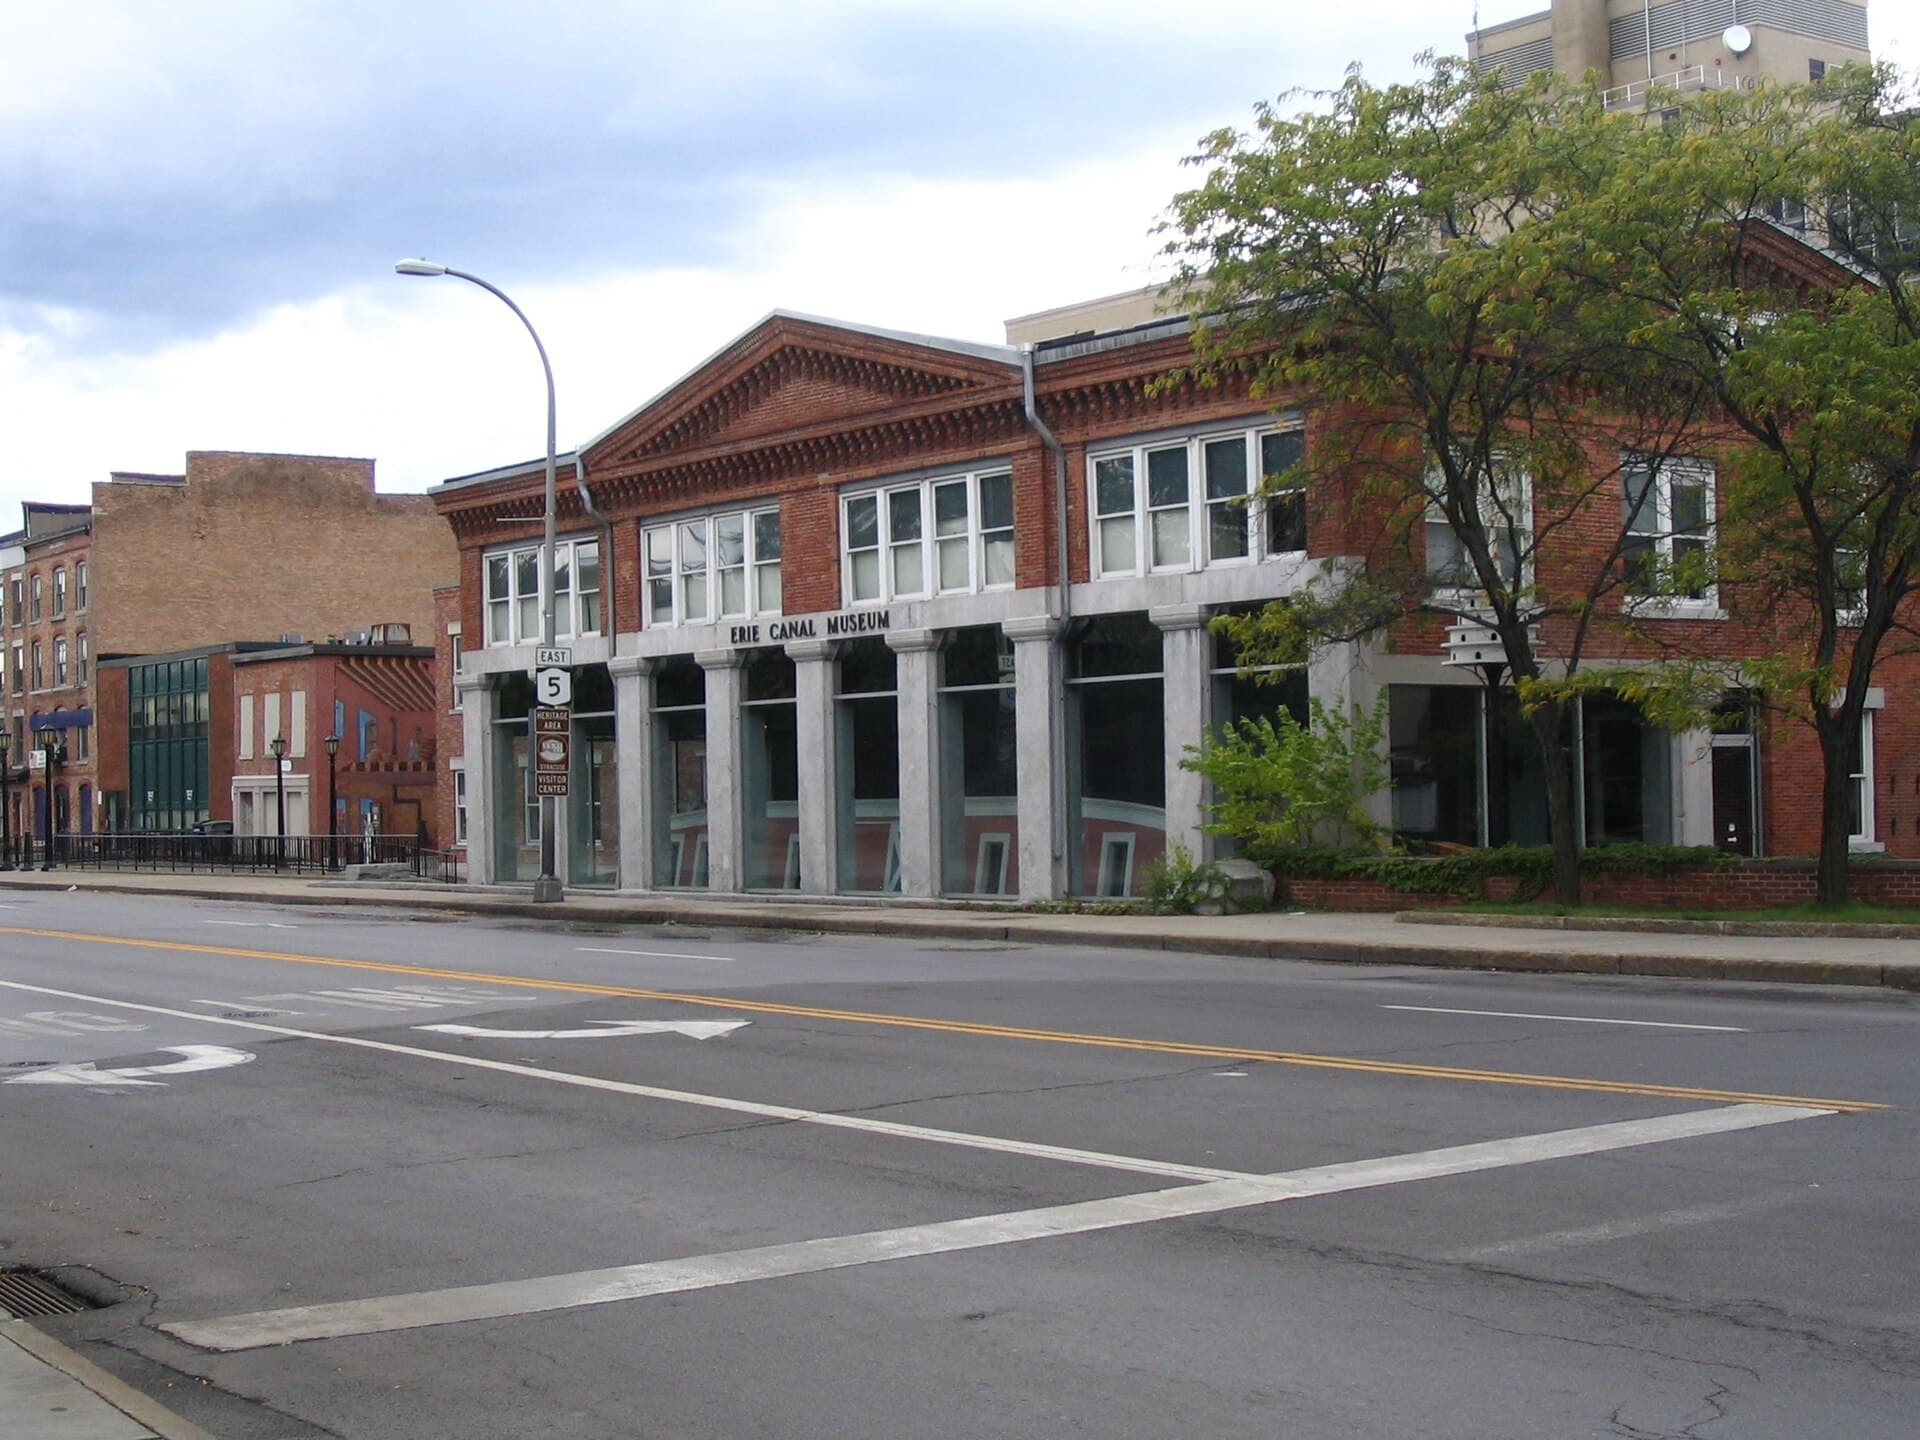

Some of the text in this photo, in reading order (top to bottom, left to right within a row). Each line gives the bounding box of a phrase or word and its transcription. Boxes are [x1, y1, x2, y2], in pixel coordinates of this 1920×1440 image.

[730, 611, 890, 643] ERIE CANAL MUSEUM
[541, 651, 567, 663] EAST
[548, 676, 561, 697] 5
[537, 711, 569, 720] HERITAGE
[544, 721, 562, 729] AREA
[538, 775, 567, 784] VISITOR
[538, 785, 567, 793] CENTER
